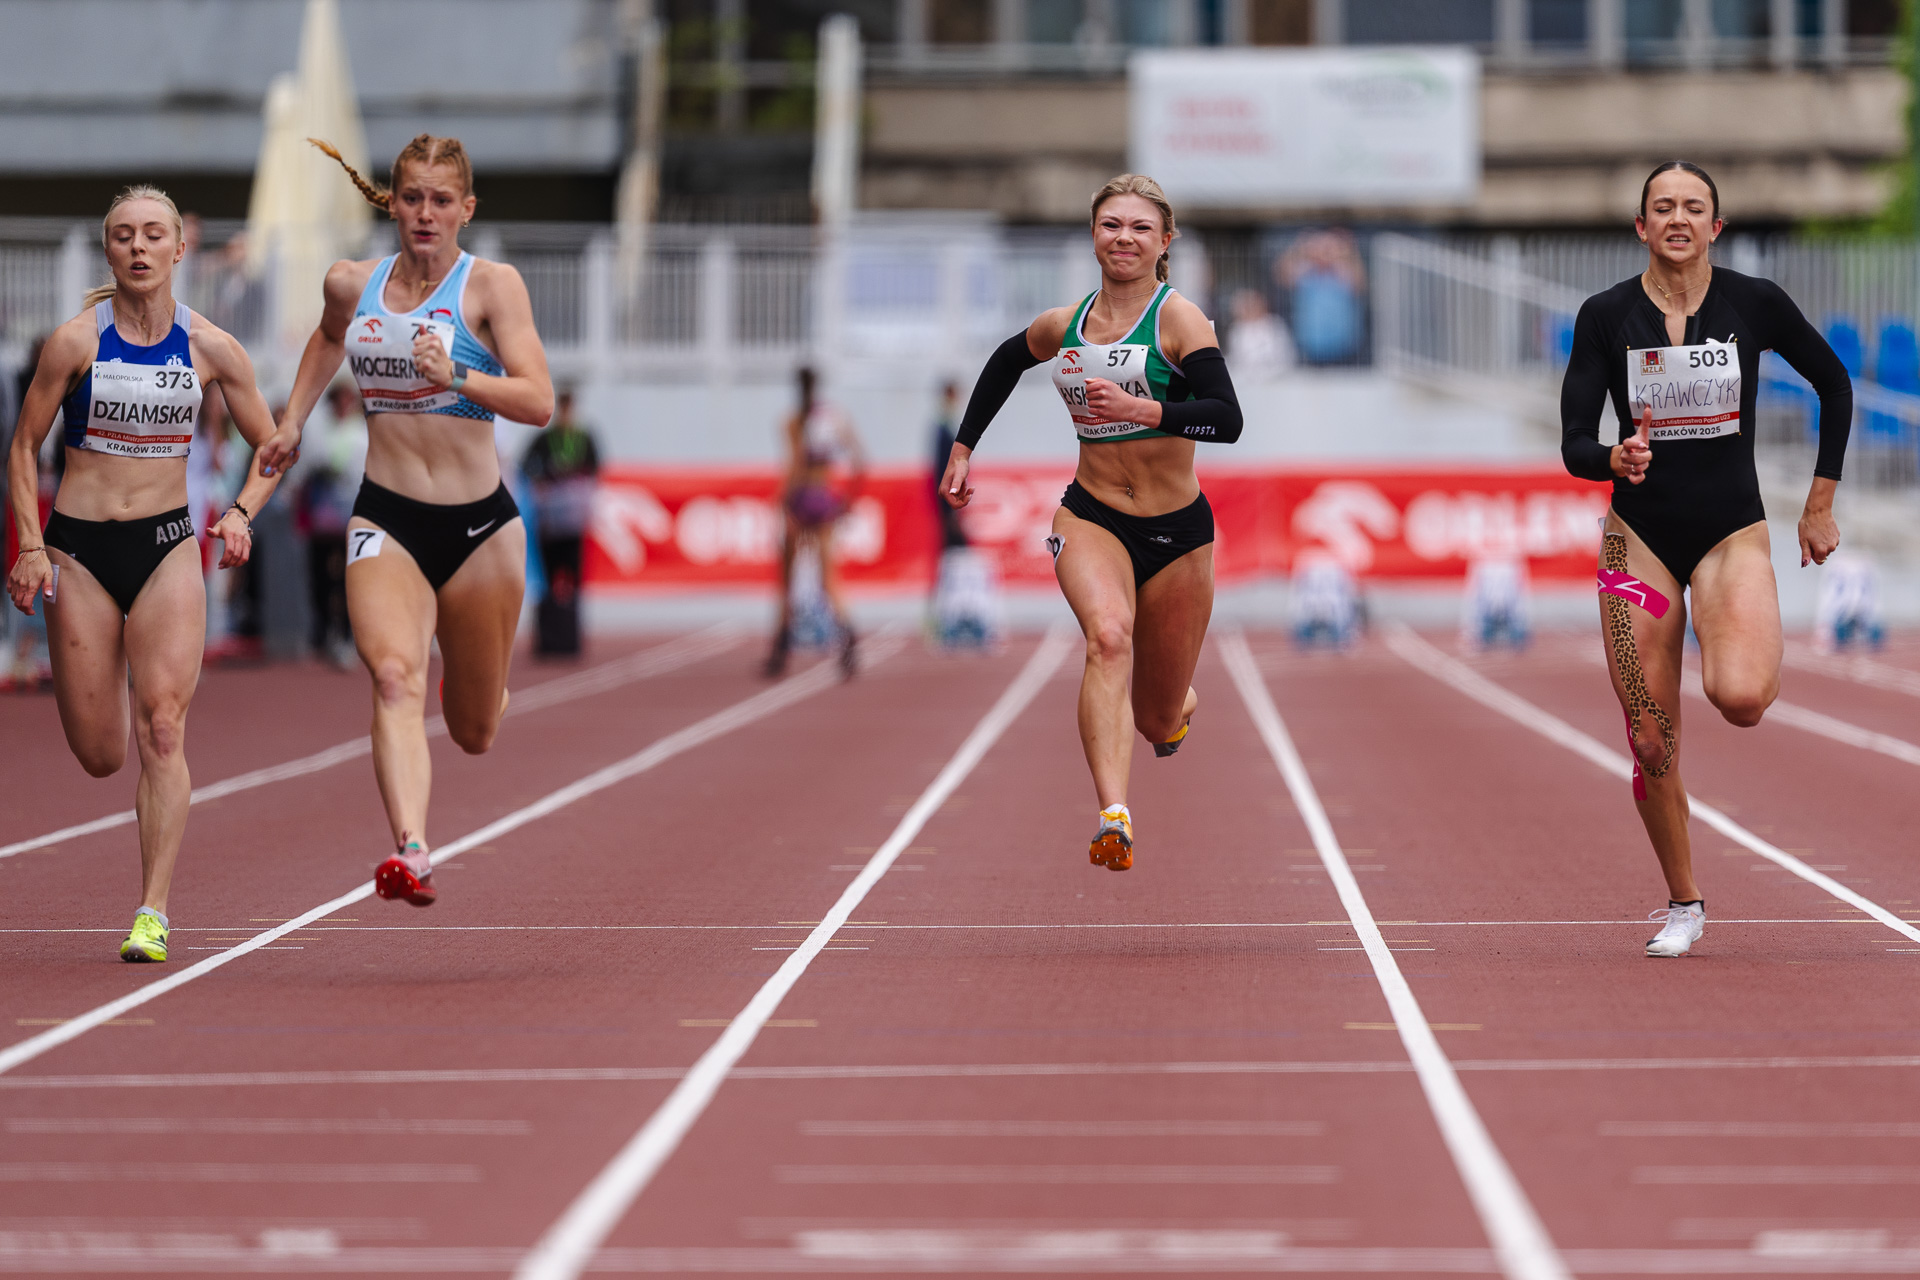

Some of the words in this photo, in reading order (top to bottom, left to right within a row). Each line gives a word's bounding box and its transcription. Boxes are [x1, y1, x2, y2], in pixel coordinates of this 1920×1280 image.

[1107, 350, 1132, 367] 57
[1689, 349, 1729, 368] 503
[1062, 367, 1083, 375] ORLEN
[1642, 366, 1664, 374] MZLA
[103, 374, 143, 382] MAŁOPOLSKA
[155, 371, 194, 389] 373
[1635, 378, 1741, 409] KRAWCZYK
[372, 400, 411, 410] KRAKÓW
[413, 398, 437, 409] 2025
[93, 400, 193, 425] DZIAMSKA
[1704, 415, 1719, 423] Polski
[1720, 413, 1731, 421] U23
[1084, 425, 1117, 436] KRAKÓW
[1118, 422, 1141, 432] 2025
[1183, 426, 1216, 435] KIPSTA
[1654, 427, 1698, 437] KRAKÓW
[1700, 426, 1720, 436] 2025
[123, 434, 156, 443] Mistrzostwa
[106, 441, 149, 454] KRAKÓW
[151, 445, 172, 454] 2025
[355, 532, 376, 558] 7
